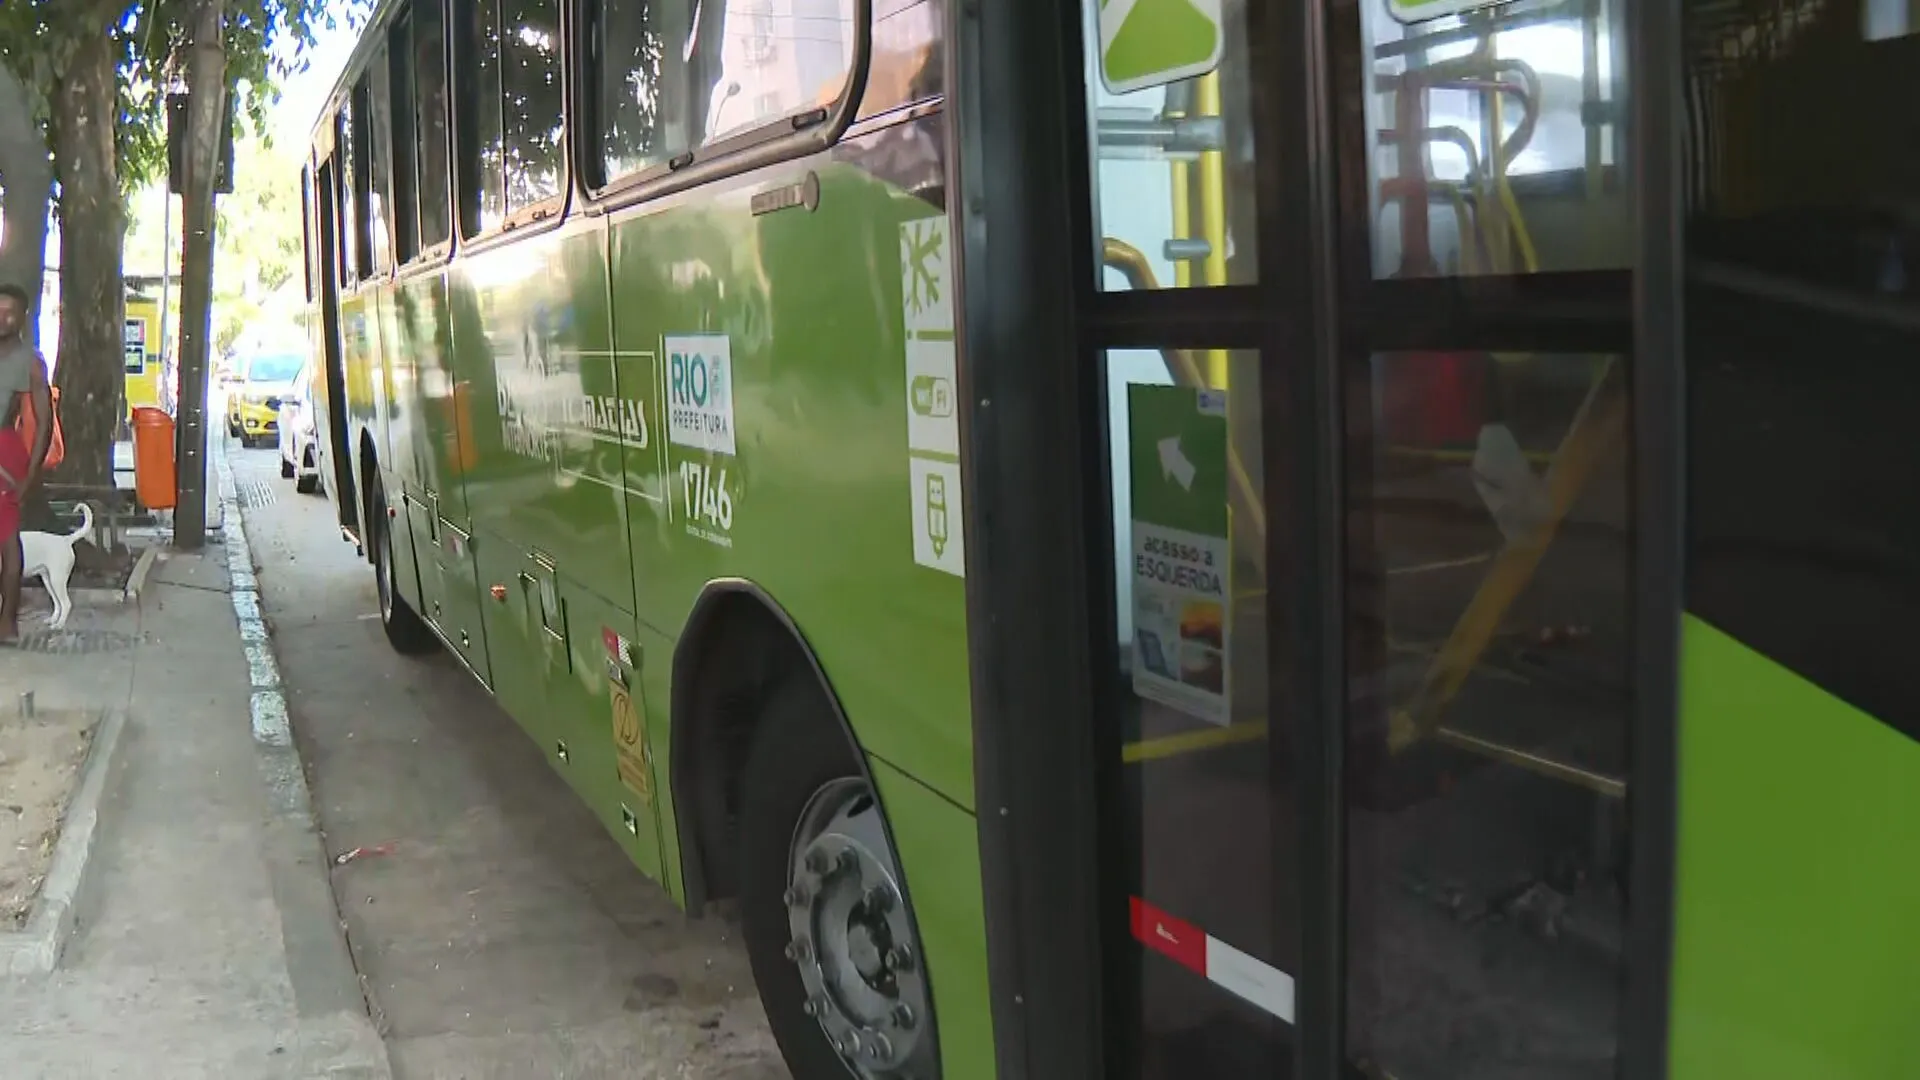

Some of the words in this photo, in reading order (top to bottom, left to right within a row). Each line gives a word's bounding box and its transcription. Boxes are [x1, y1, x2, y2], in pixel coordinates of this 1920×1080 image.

[671, 352, 707, 408] RIO
[673, 409, 728, 436] PREFEITURA
[680, 460, 732, 530] 1746
[1136, 553, 1222, 596] ESQUERDA
